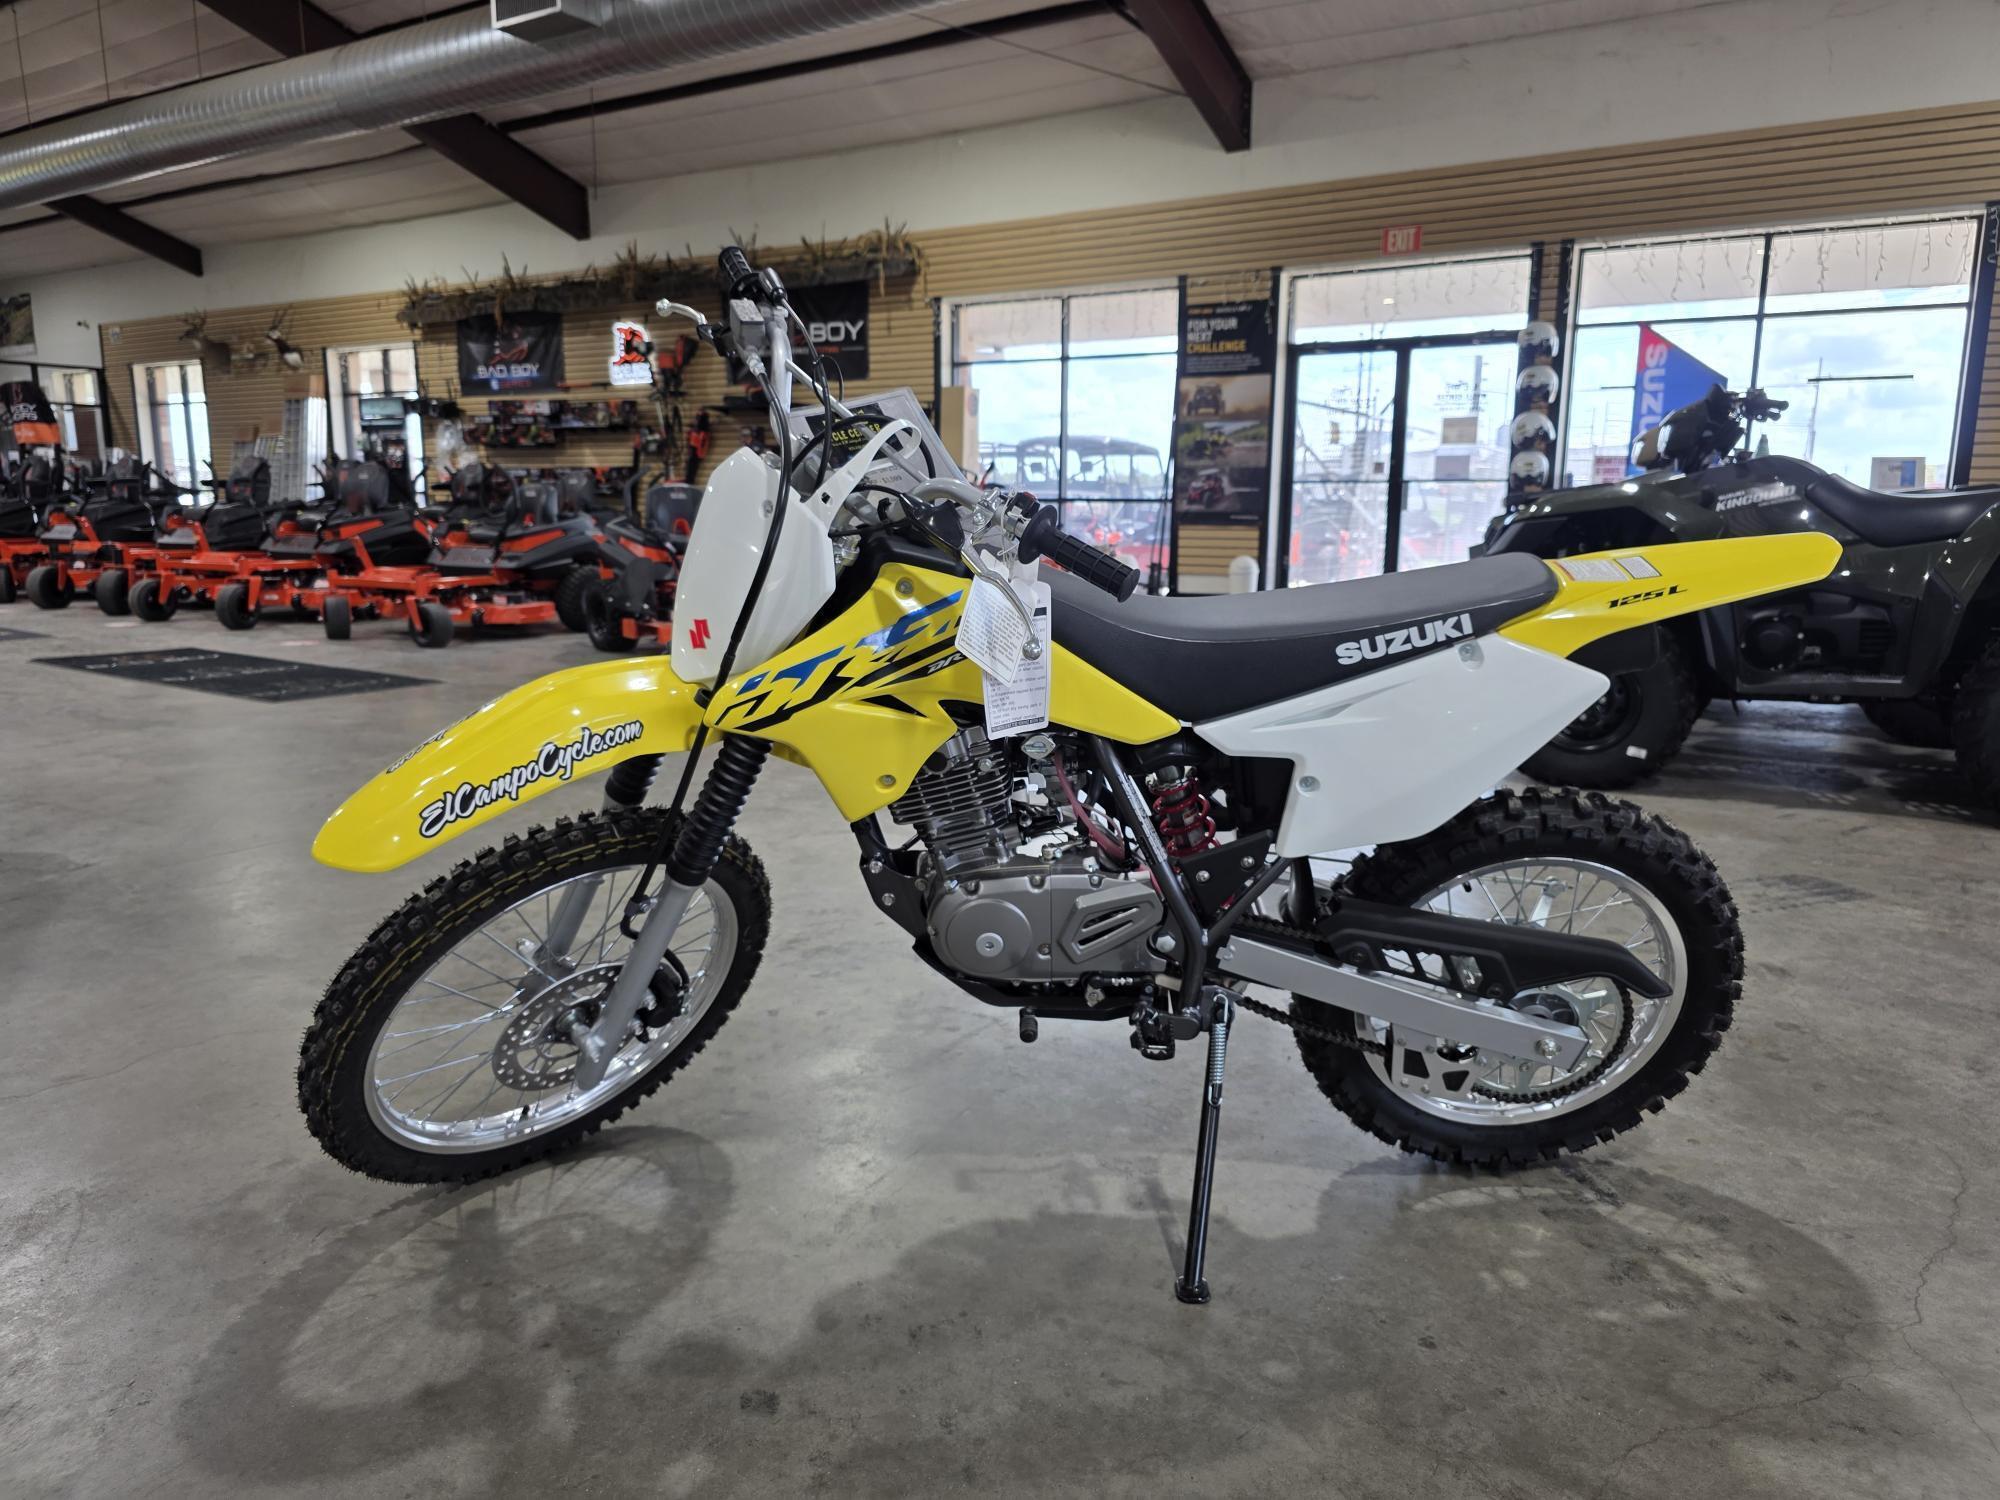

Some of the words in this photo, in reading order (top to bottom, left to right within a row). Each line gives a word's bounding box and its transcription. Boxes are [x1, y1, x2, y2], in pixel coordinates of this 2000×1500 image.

[1388, 229, 1416, 251] EXIT
[809, 320, 864, 343] BOY
[477, 364, 507, 379] BAD
[510, 363, 540, 377] BOY
[1639, 343, 1668, 434] SUZU
[1715, 484, 1797, 513] KINGQUAD
[1335, 613, 1474, 666] SUZUKI
[419, 719, 645, 839] ElCampoCycle.com
